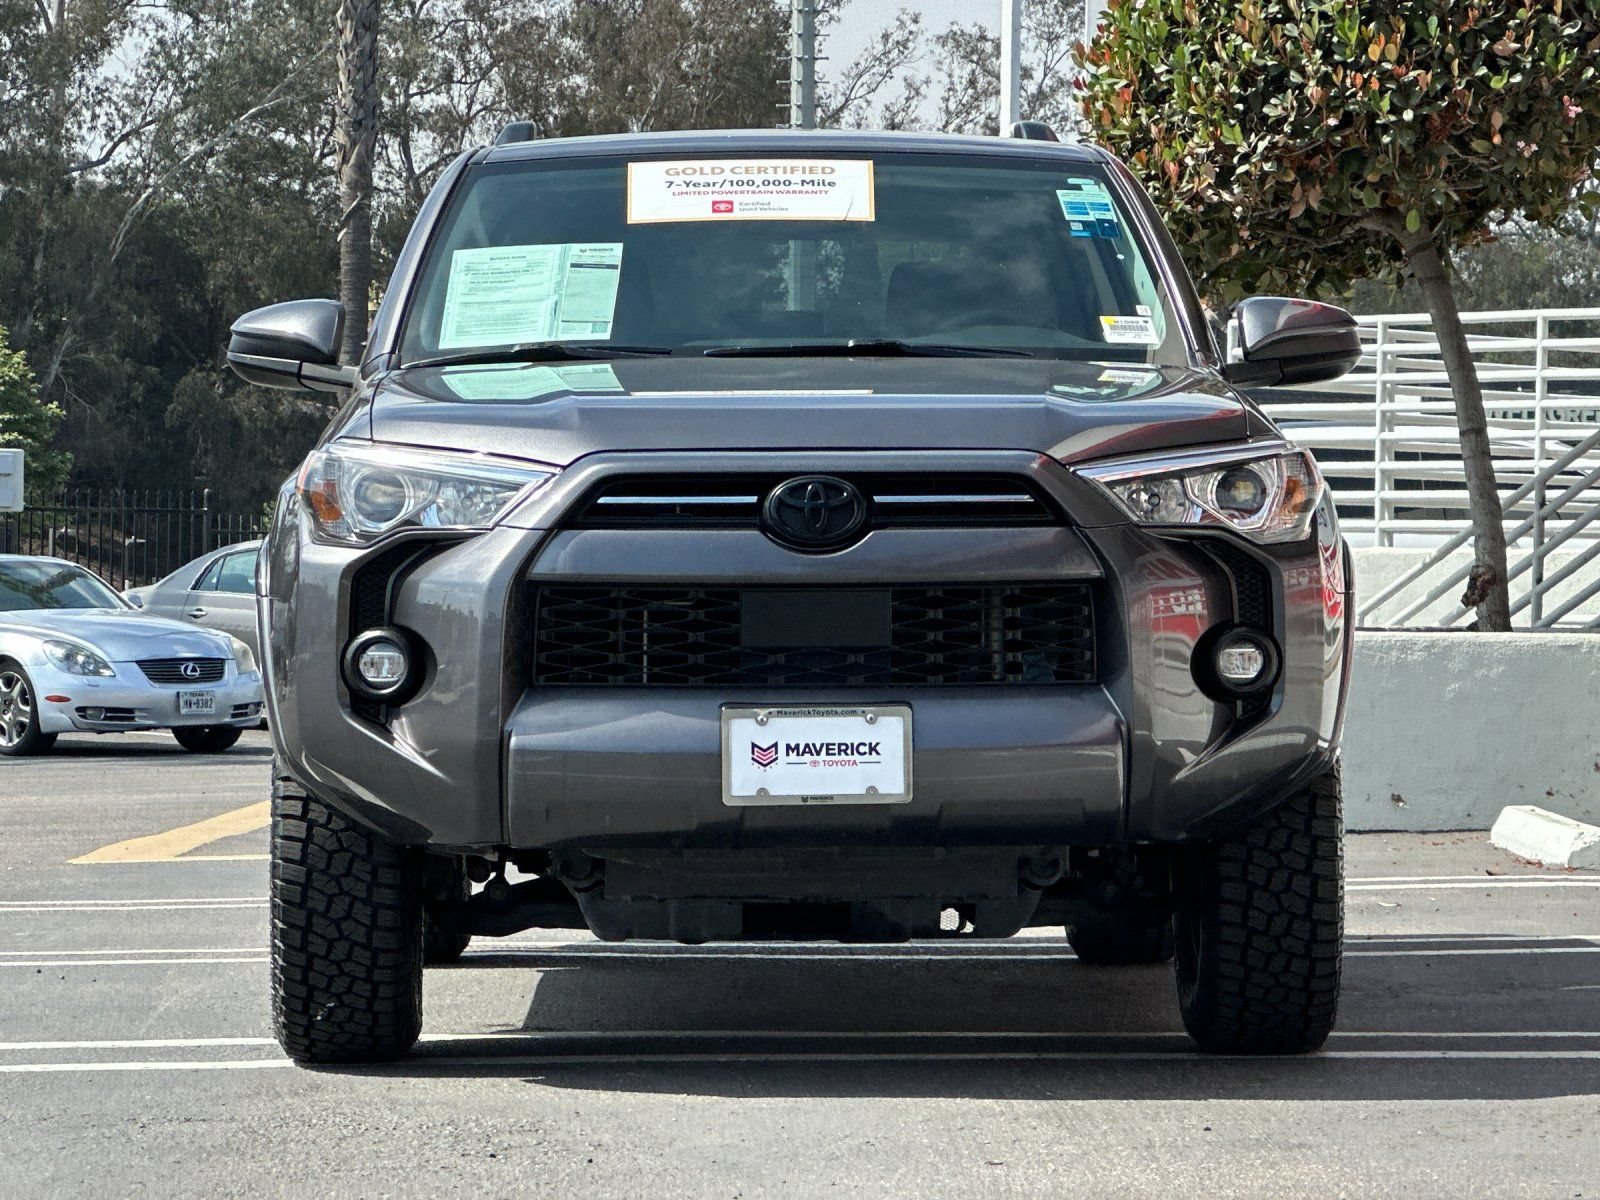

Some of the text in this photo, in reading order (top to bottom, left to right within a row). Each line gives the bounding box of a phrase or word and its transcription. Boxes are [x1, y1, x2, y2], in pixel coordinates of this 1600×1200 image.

[665, 165, 837, 177] GOLD CERTIFIED
[664, 178, 837, 189] 7-Year/100,000-Mile
[776, 708, 858, 717] MaverickToyota.com
[785, 741, 882, 757] MAVERICK
[821, 759, 859, 767] TOYOTA
